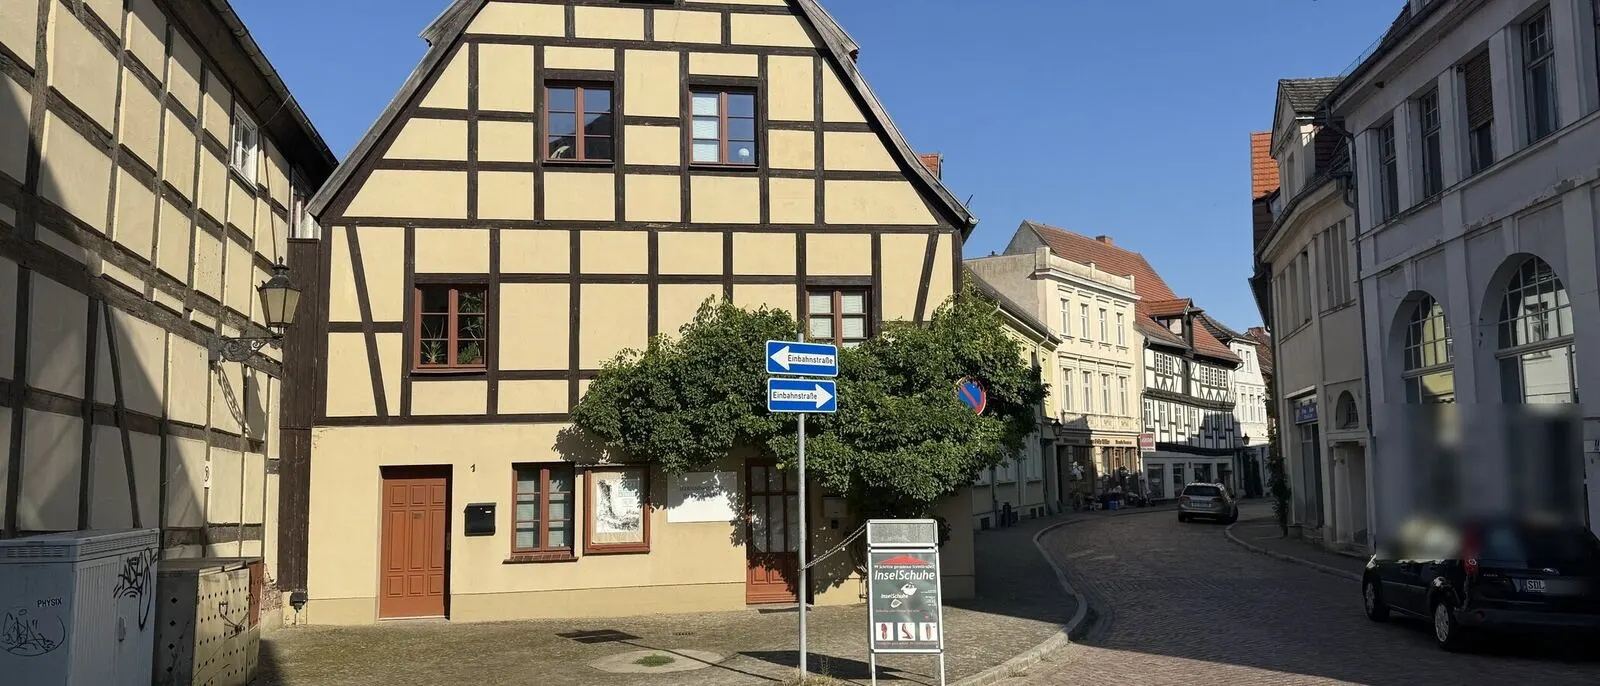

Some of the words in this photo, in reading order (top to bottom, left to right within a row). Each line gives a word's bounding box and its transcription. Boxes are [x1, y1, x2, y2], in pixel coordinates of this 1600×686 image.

[788, 355, 833, 364] Einbahnstraße
[470, 464, 476, 473] 1
[874, 570, 935, 580] InselSchuhe
[37, 598, 62, 608] PHYSIX
